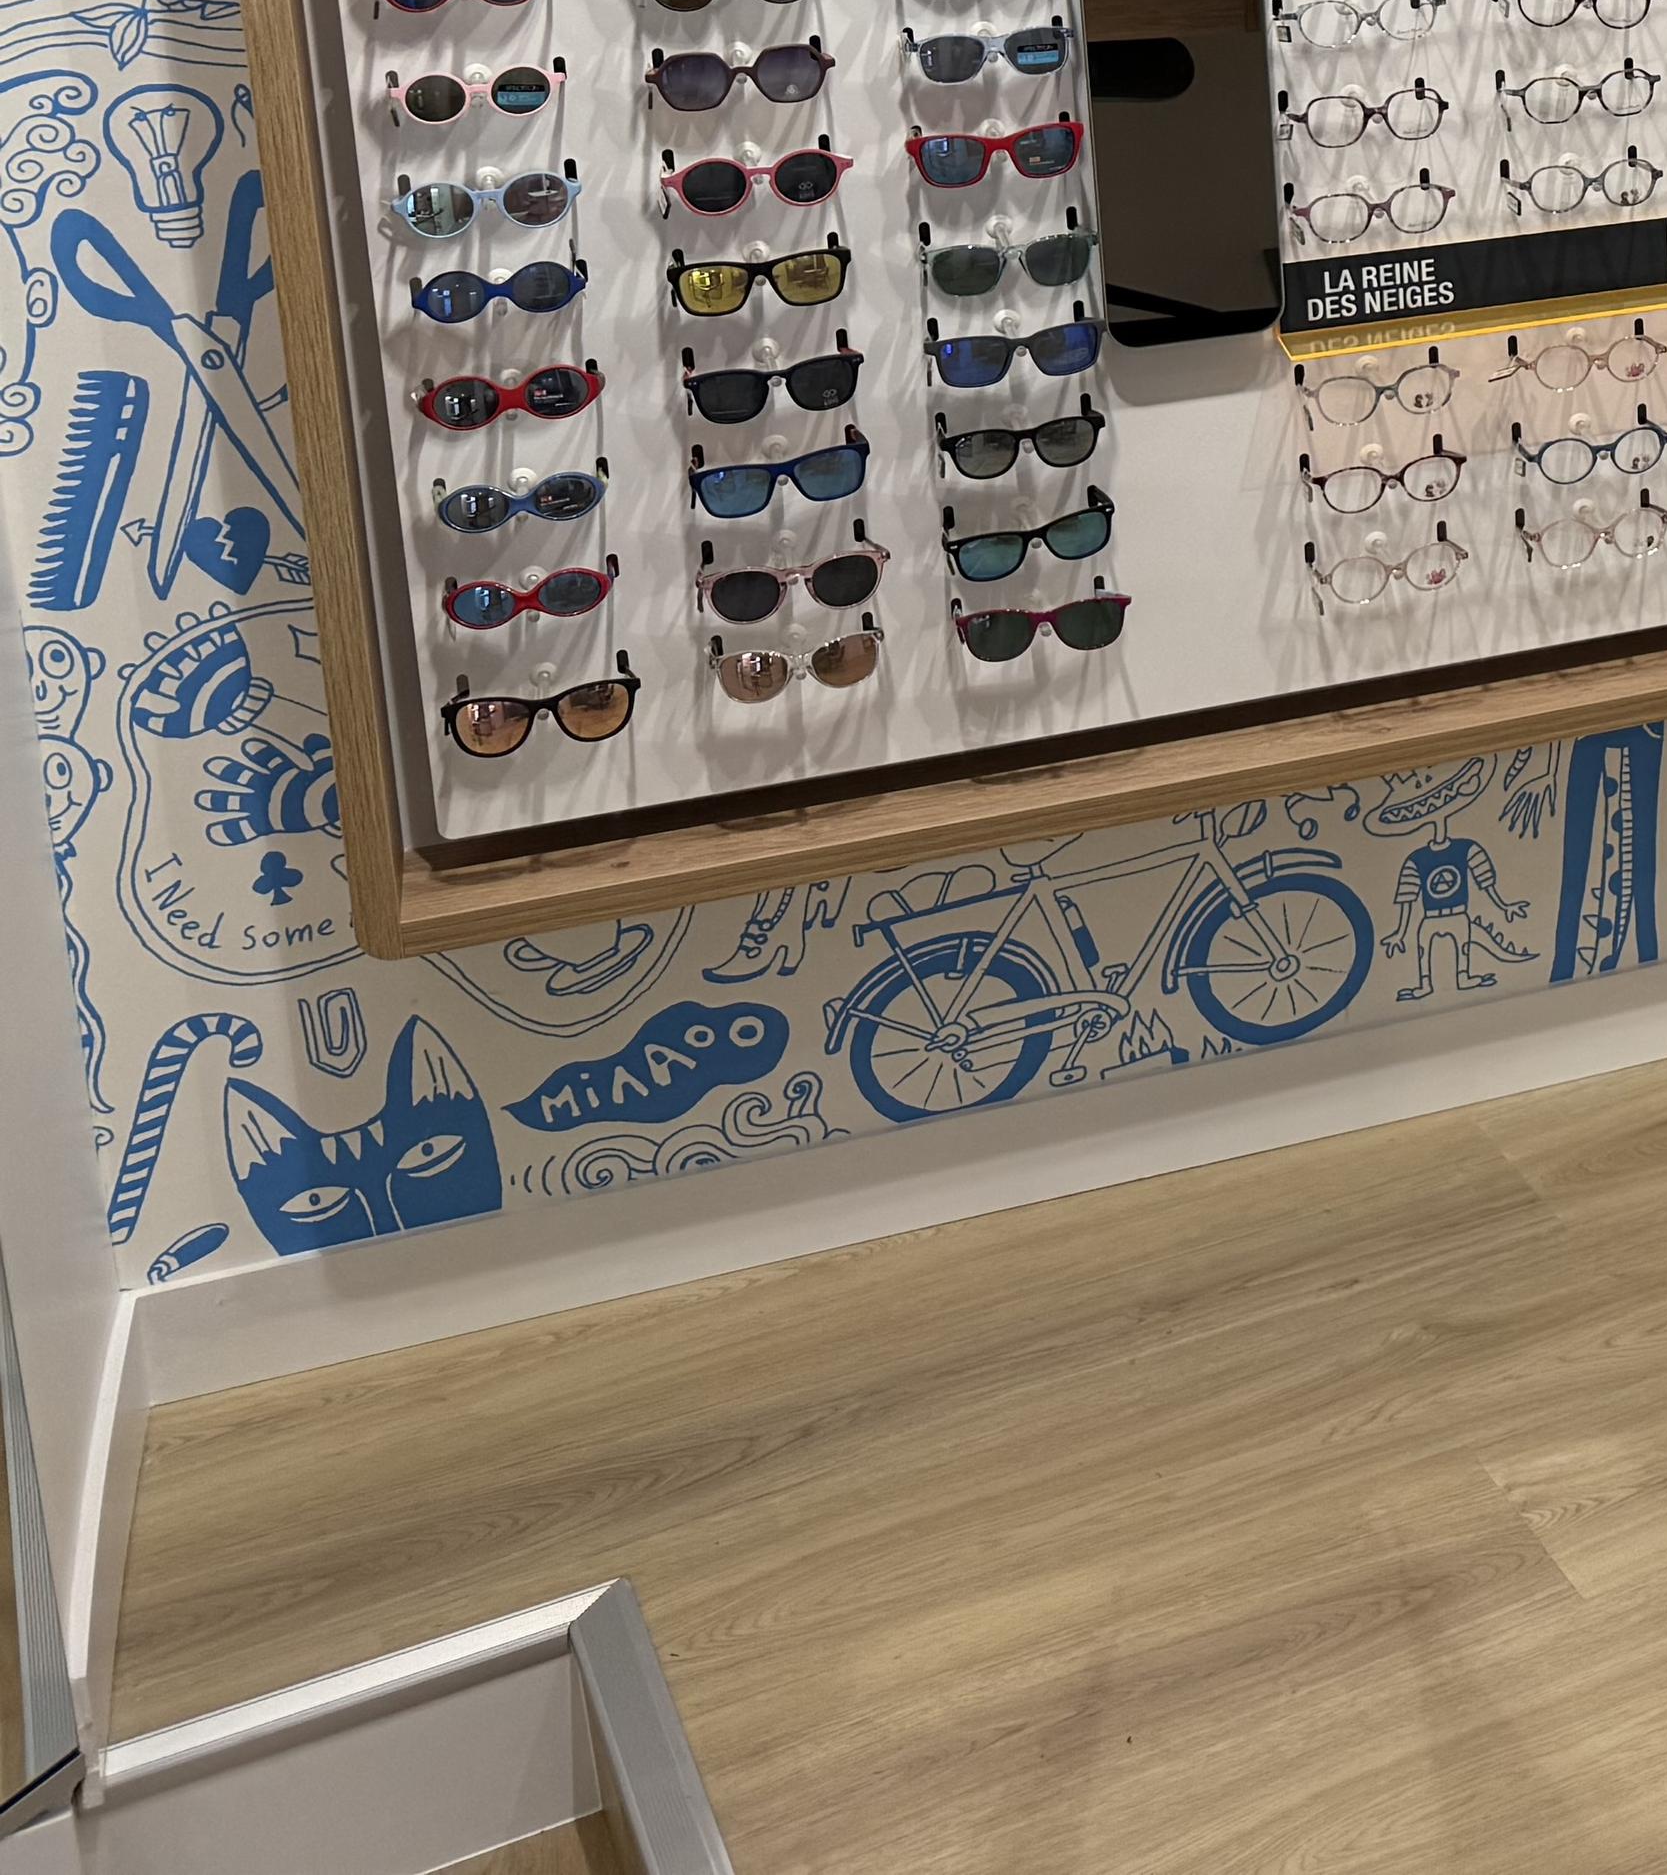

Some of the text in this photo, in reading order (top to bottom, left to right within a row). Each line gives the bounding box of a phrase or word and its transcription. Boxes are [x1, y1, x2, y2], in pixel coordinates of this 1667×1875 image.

[1323, 258, 1436, 295] LA REINE
[1306, 281, 1455, 322] DES NEIGES
